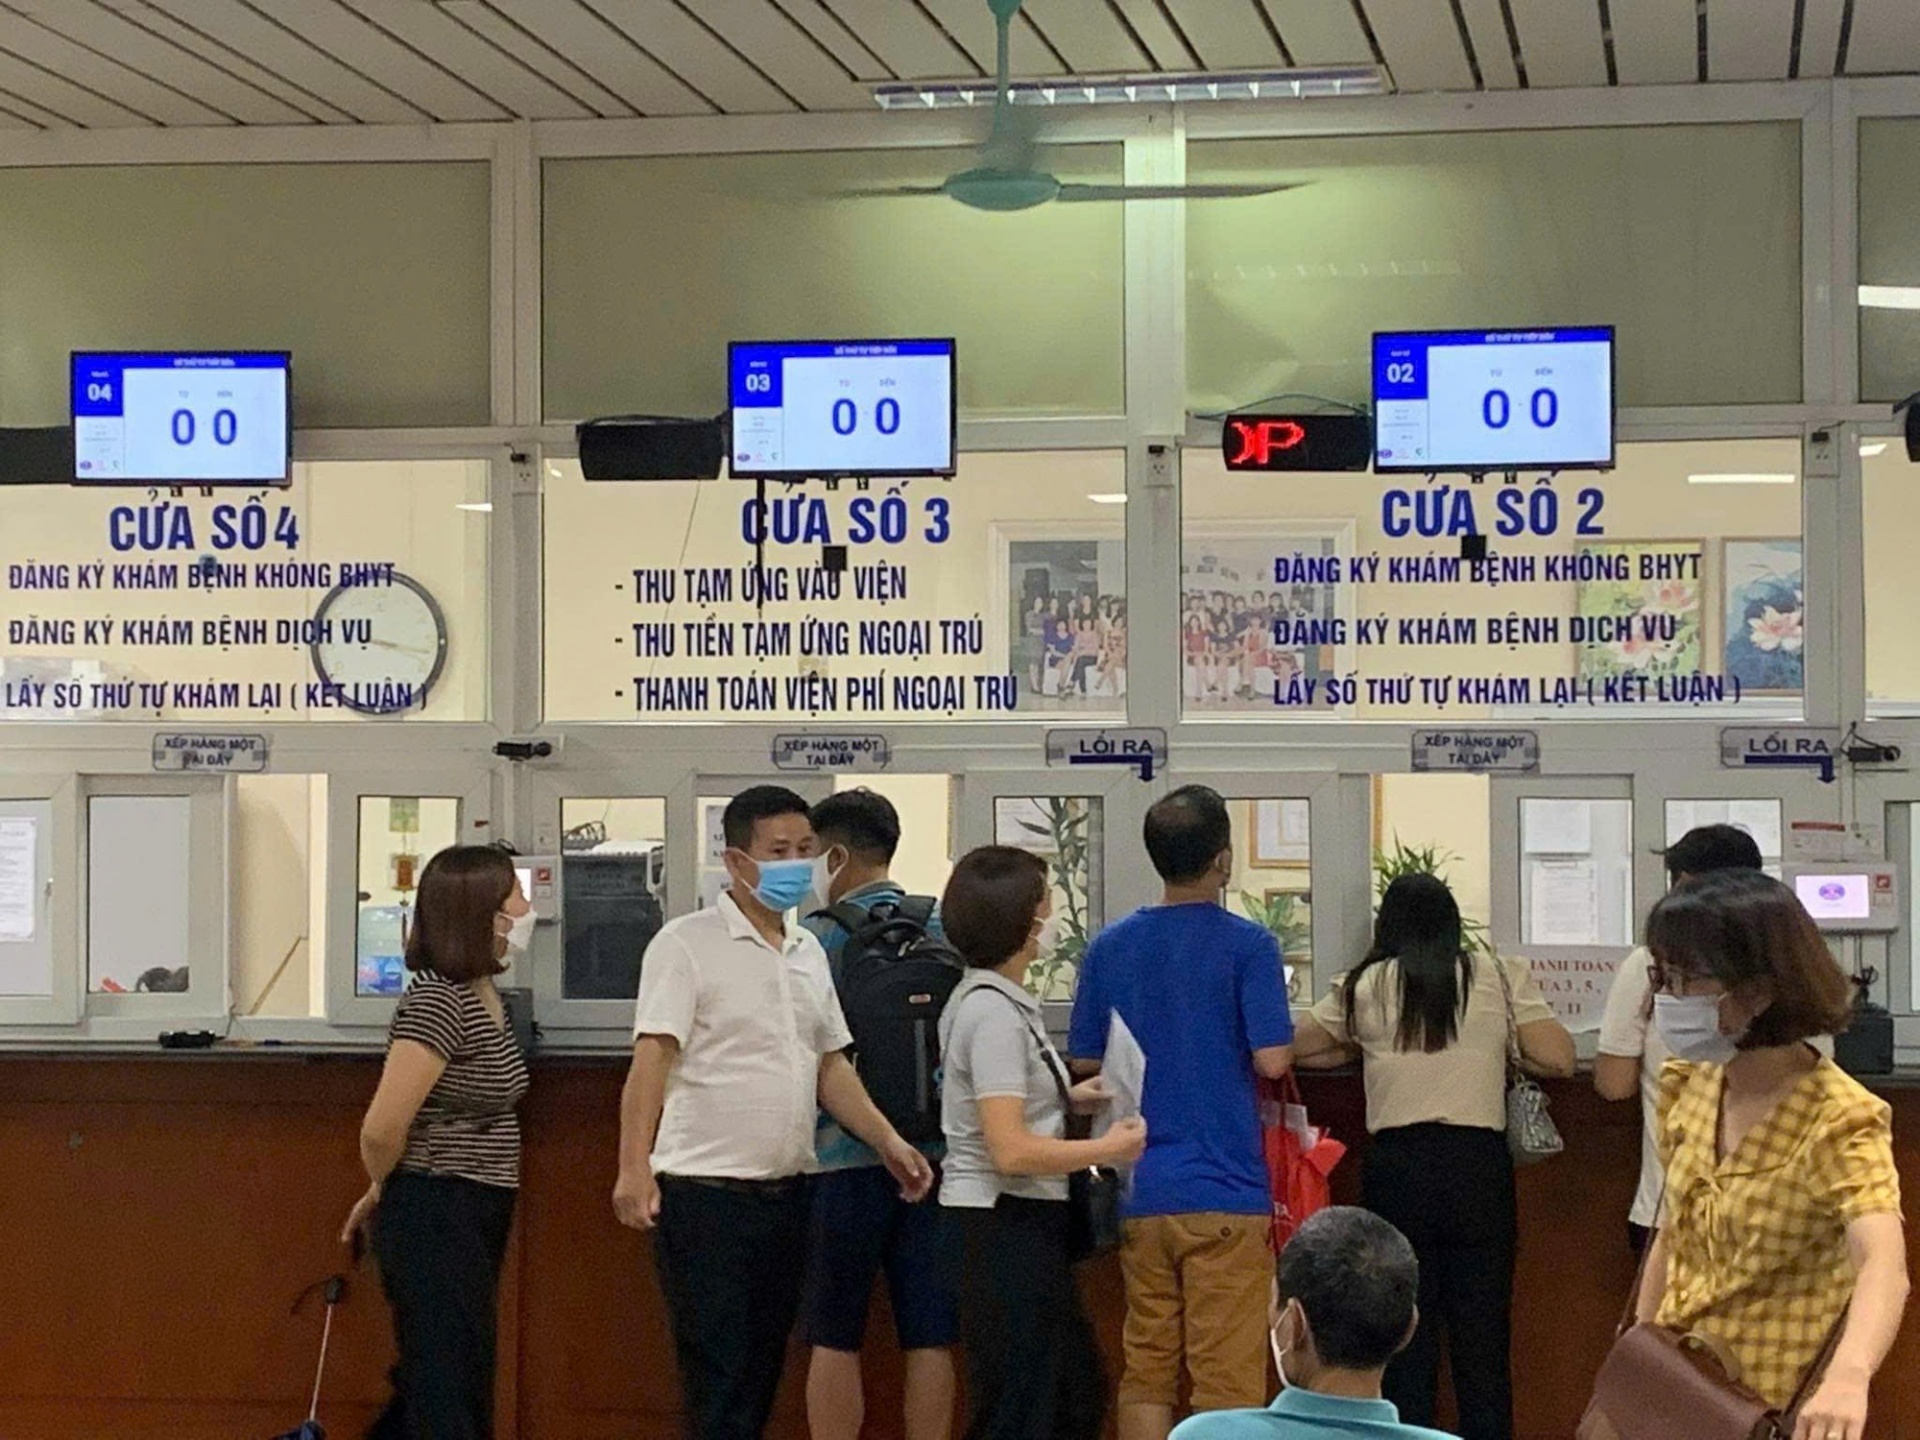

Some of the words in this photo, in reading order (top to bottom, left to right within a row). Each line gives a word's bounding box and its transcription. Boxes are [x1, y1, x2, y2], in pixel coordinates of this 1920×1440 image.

[87, 383, 112, 401] 04
[746, 373, 770, 392] 03
[1387, 363, 1414, 383] 02
[171, 408, 195, 445] 0
[213, 408, 237, 445] 0
[832, 398, 857, 435] 0
[875, 397, 900, 435] 0
[1483, 389, 1510, 429] 0
[1531, 388, 1558, 428] 0
[110, 488, 195, 551] CỬA
[211, 490, 269, 550] SỐ
[274, 505, 299, 550] 4
[742, 482, 831, 544] CỬA
[848, 480, 909, 544] SỐ
[924, 497, 949, 543] 3
[1382, 472, 1477, 537] CỬA
[1496, 471, 1559, 536] SỐ
[1577, 488, 1604, 535] 2
[9, 559, 69, 589] ĐĂNG
[78, 559, 104, 589] KÝ
[113, 558, 178, 589] KHÁM
[188, 563, 247, 593] BỆNH
[340, 562, 395, 588] BHYT
[633, 569, 675, 604] THU
[684, 568, 732, 608] TẠM
[741, 560, 788, 602] ỨNG
[853, 559, 906, 605] VIỆN
[1274, 552, 1340, 583] ĐĂNG
[1350, 551, 1380, 583] KÝ
[1389, 551, 1460, 583] KHÁM
[1470, 551, 1535, 587] BỆNH
[1545, 549, 1629, 582] KHÔNG
[1640, 554, 1702, 580] BHYT
[9, 614, 76, 645] ĐĂNG
[84, 614, 114, 645] KÝ
[123, 614, 193, 645] KHÁM
[203, 614, 267, 651] BỆNH
[276, 619, 332, 650] DỊCH
[341, 619, 371, 650] VỤ
[633, 623, 675, 657] THU
[684, 612, 734, 657] TIỀN
[743, 622, 791, 662] TẠM
[800, 614, 849, 656] ỨNG
[860, 620, 930, 661] NGOẠI
[939, 612, 982, 655] TRÚ
[1274, 612, 1346, 645] ĐĂNG
[1357, 612, 1389, 645] KÝ
[1399, 612, 1477, 645] KHÁM
[1487, 612, 1558, 650] BỆNH
[1570, 616, 1632, 649] DỊCH
[1643, 614, 1676, 648] VỤ
[6, 675, 45, 707] LẤY
[54, 674, 84, 708] SỐ
[90, 676, 134, 708] THỨ
[139, 680, 168, 717] TỰ
[174, 677, 239, 708] KHÁM
[248, 683, 281, 714] LẠI
[633, 677, 708, 711] THANH
[717, 669, 776, 711] TOÁN
[786, 670, 837, 717] VIỆN
[847, 668, 884, 711] PHÍ
[894, 676, 964, 716] NGOẠI
[974, 669, 1017, 710] TRÚ
[1274, 670, 1316, 704] LẤY
[1326, 670, 1358, 704] SỐ
[1366, 672, 1414, 704] THỨ
[1420, 674, 1452, 709] TỰ
[1458, 672, 1530, 705] KHÁM
[1540, 677, 1577, 708] LẠI
[1604, 667, 1649, 703] KẾT
[1658, 669, 1723, 707] LUẬN
[852, 737, 878, 753] MỘT
[1080, 729, 1115, 753] LỐI
[1123, 739, 1153, 753] RA
[1496, 735, 1526, 750] MỘT
[1749, 731, 1787, 753] LỐI
[1796, 739, 1829, 753] RA
